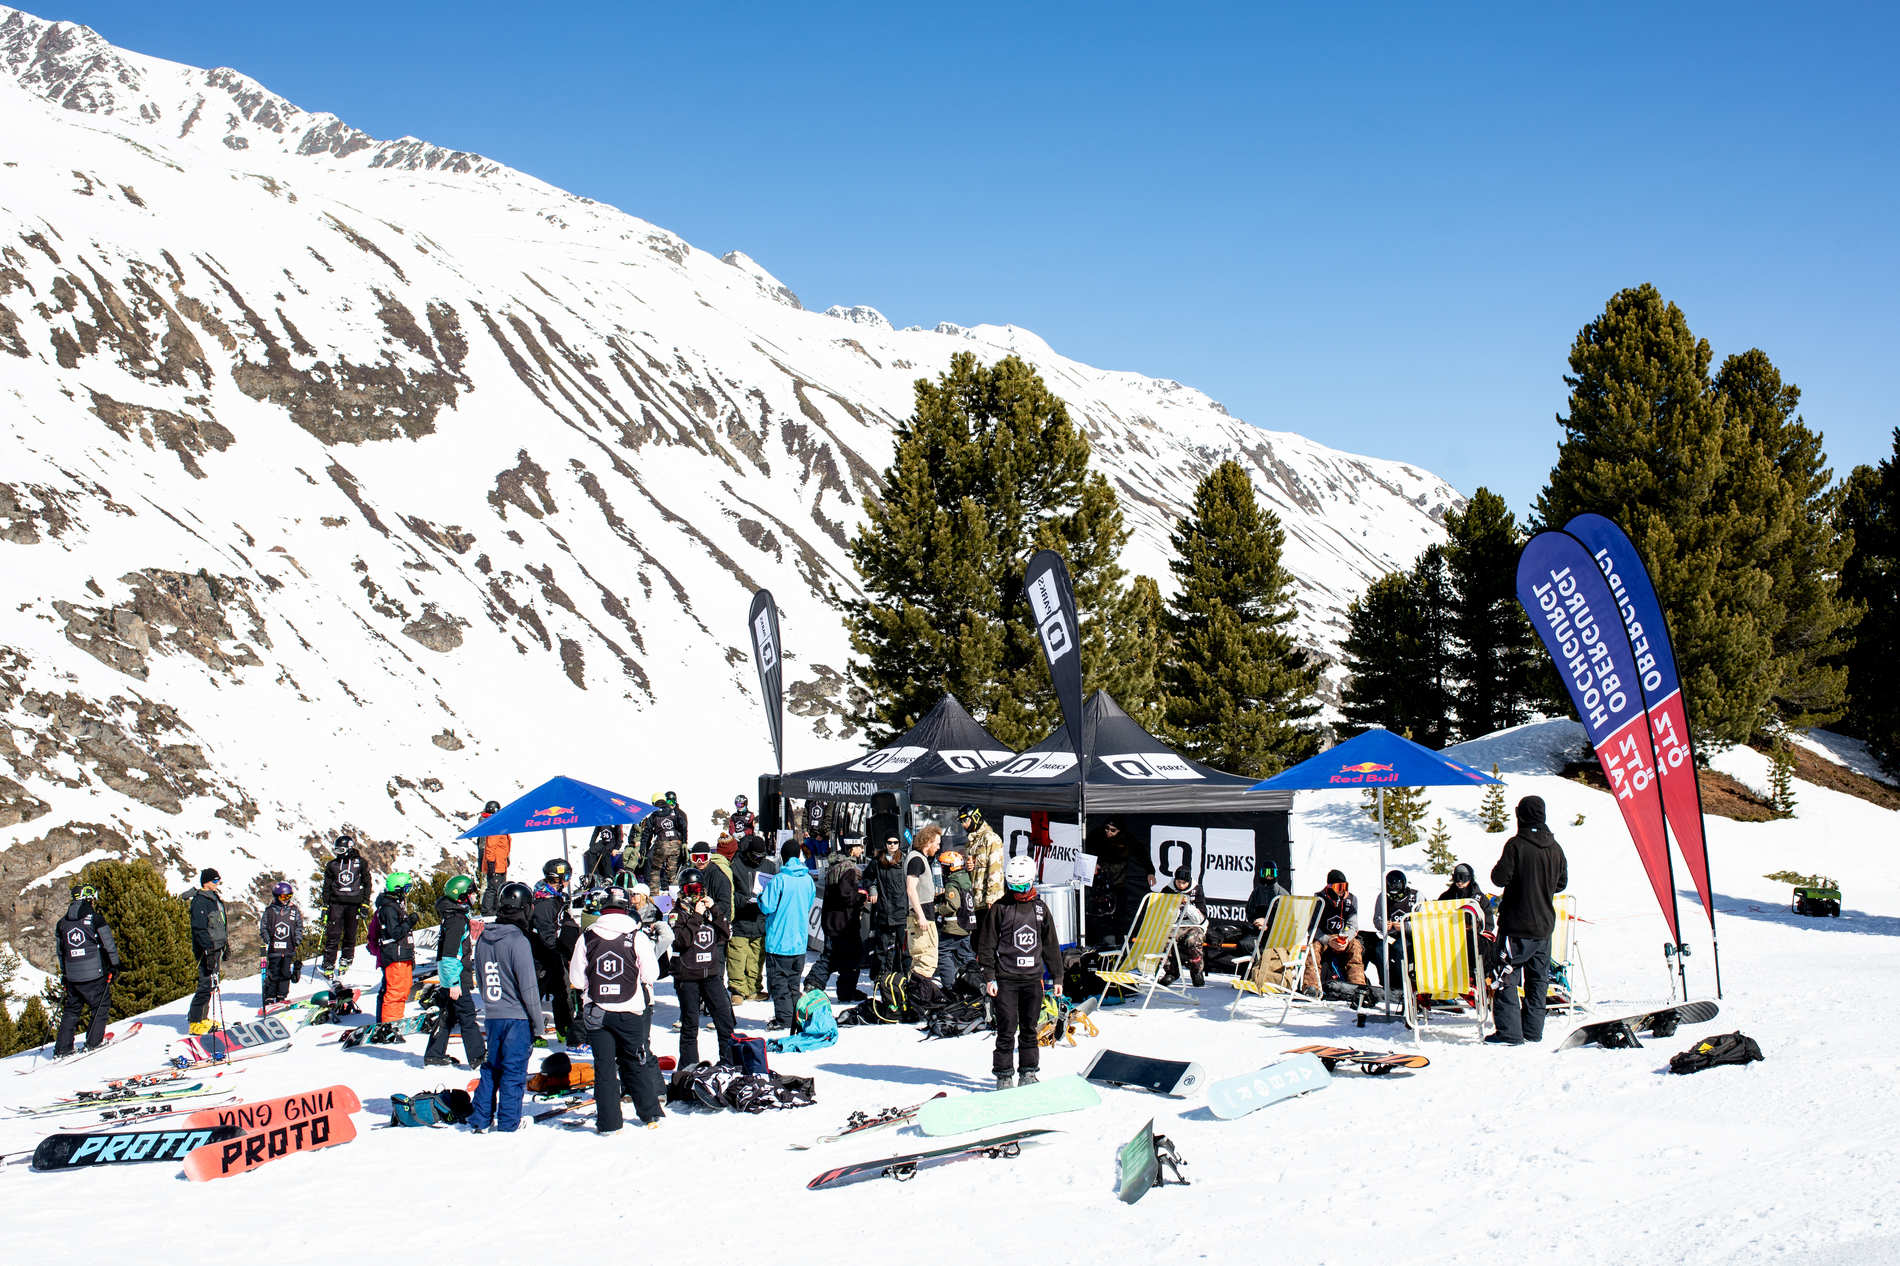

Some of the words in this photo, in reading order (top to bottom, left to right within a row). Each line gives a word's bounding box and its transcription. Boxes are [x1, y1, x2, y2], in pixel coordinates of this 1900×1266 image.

[1156, 764, 1188, 772] PARKS
[1329, 775, 1363, 783] Red
[1366, 773, 1399, 782] Bull
[525, 818, 551, 827] Red
[553, 815, 578, 825] Bull
[1206, 853, 1254, 872] PARKS
[1018, 933, 1034, 945] 123
[603, 959, 617, 972] 81
[485, 961, 502, 1001] GBR
[68, 1130, 213, 1165] PROTO
[222, 1115, 330, 1174] PROTO
